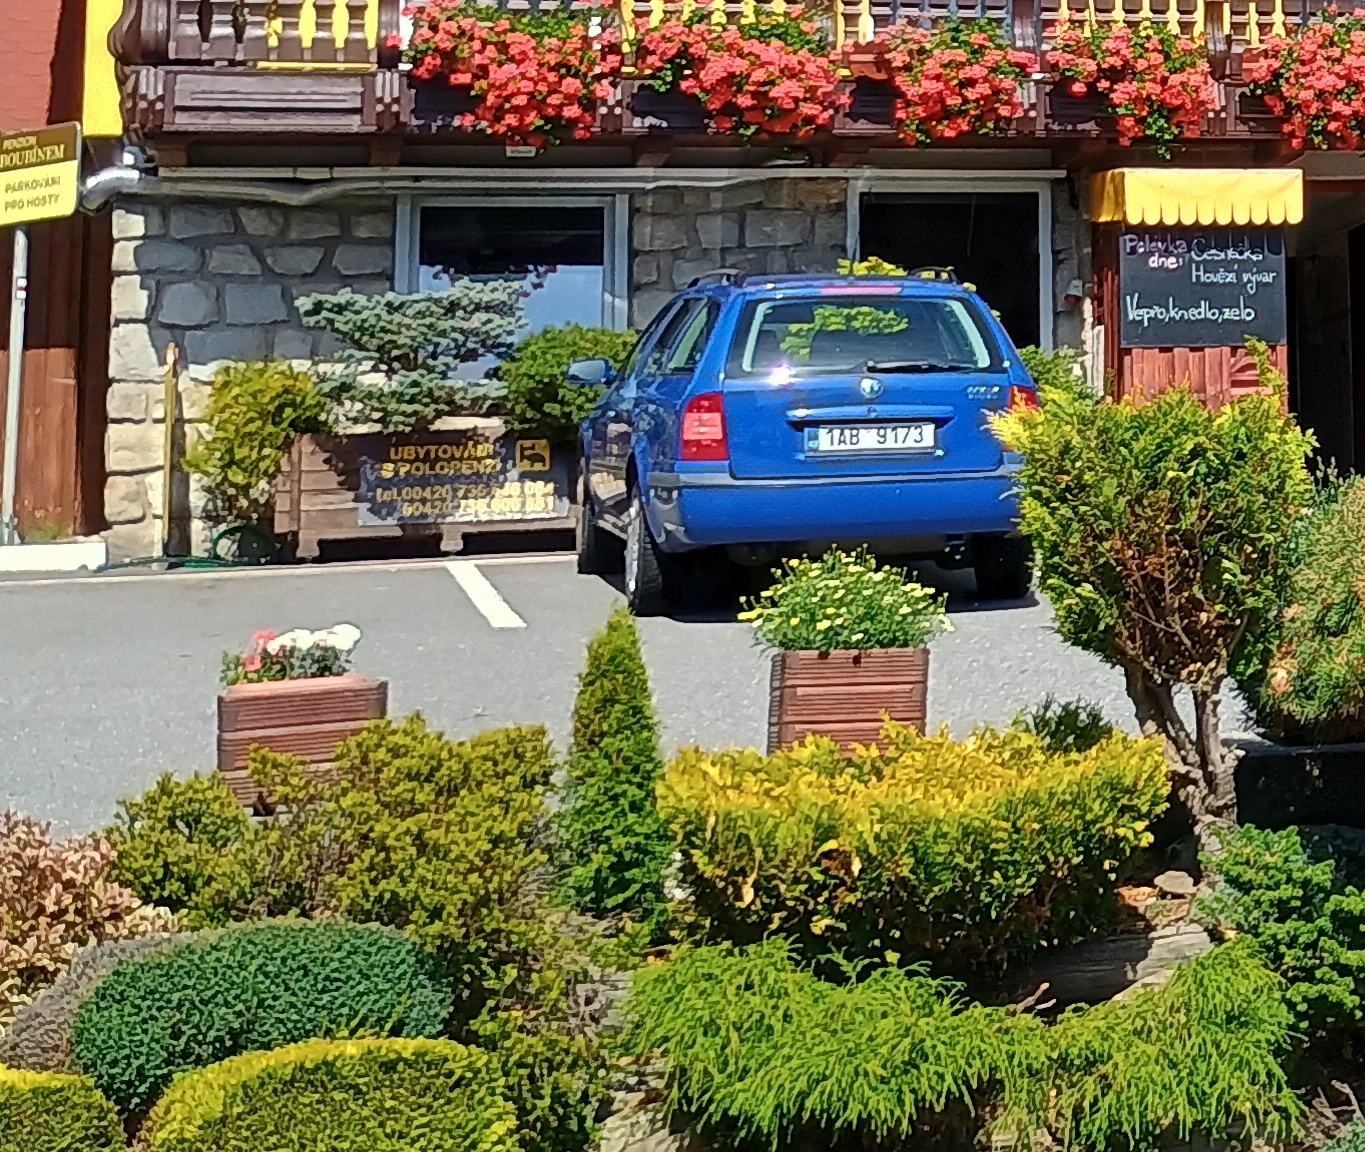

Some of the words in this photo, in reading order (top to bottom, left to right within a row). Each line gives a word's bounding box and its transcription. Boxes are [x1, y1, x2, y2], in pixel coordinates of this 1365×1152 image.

[5, 198, 25, 212] PRO
[27, 193, 60, 208] HOSTY
[1191, 263, 1239, 283] Hovězí
[1242, 267, 1277, 295] vývar
[826, 429, 861, 447] 1AB
[876, 425, 924, 445] 9173
